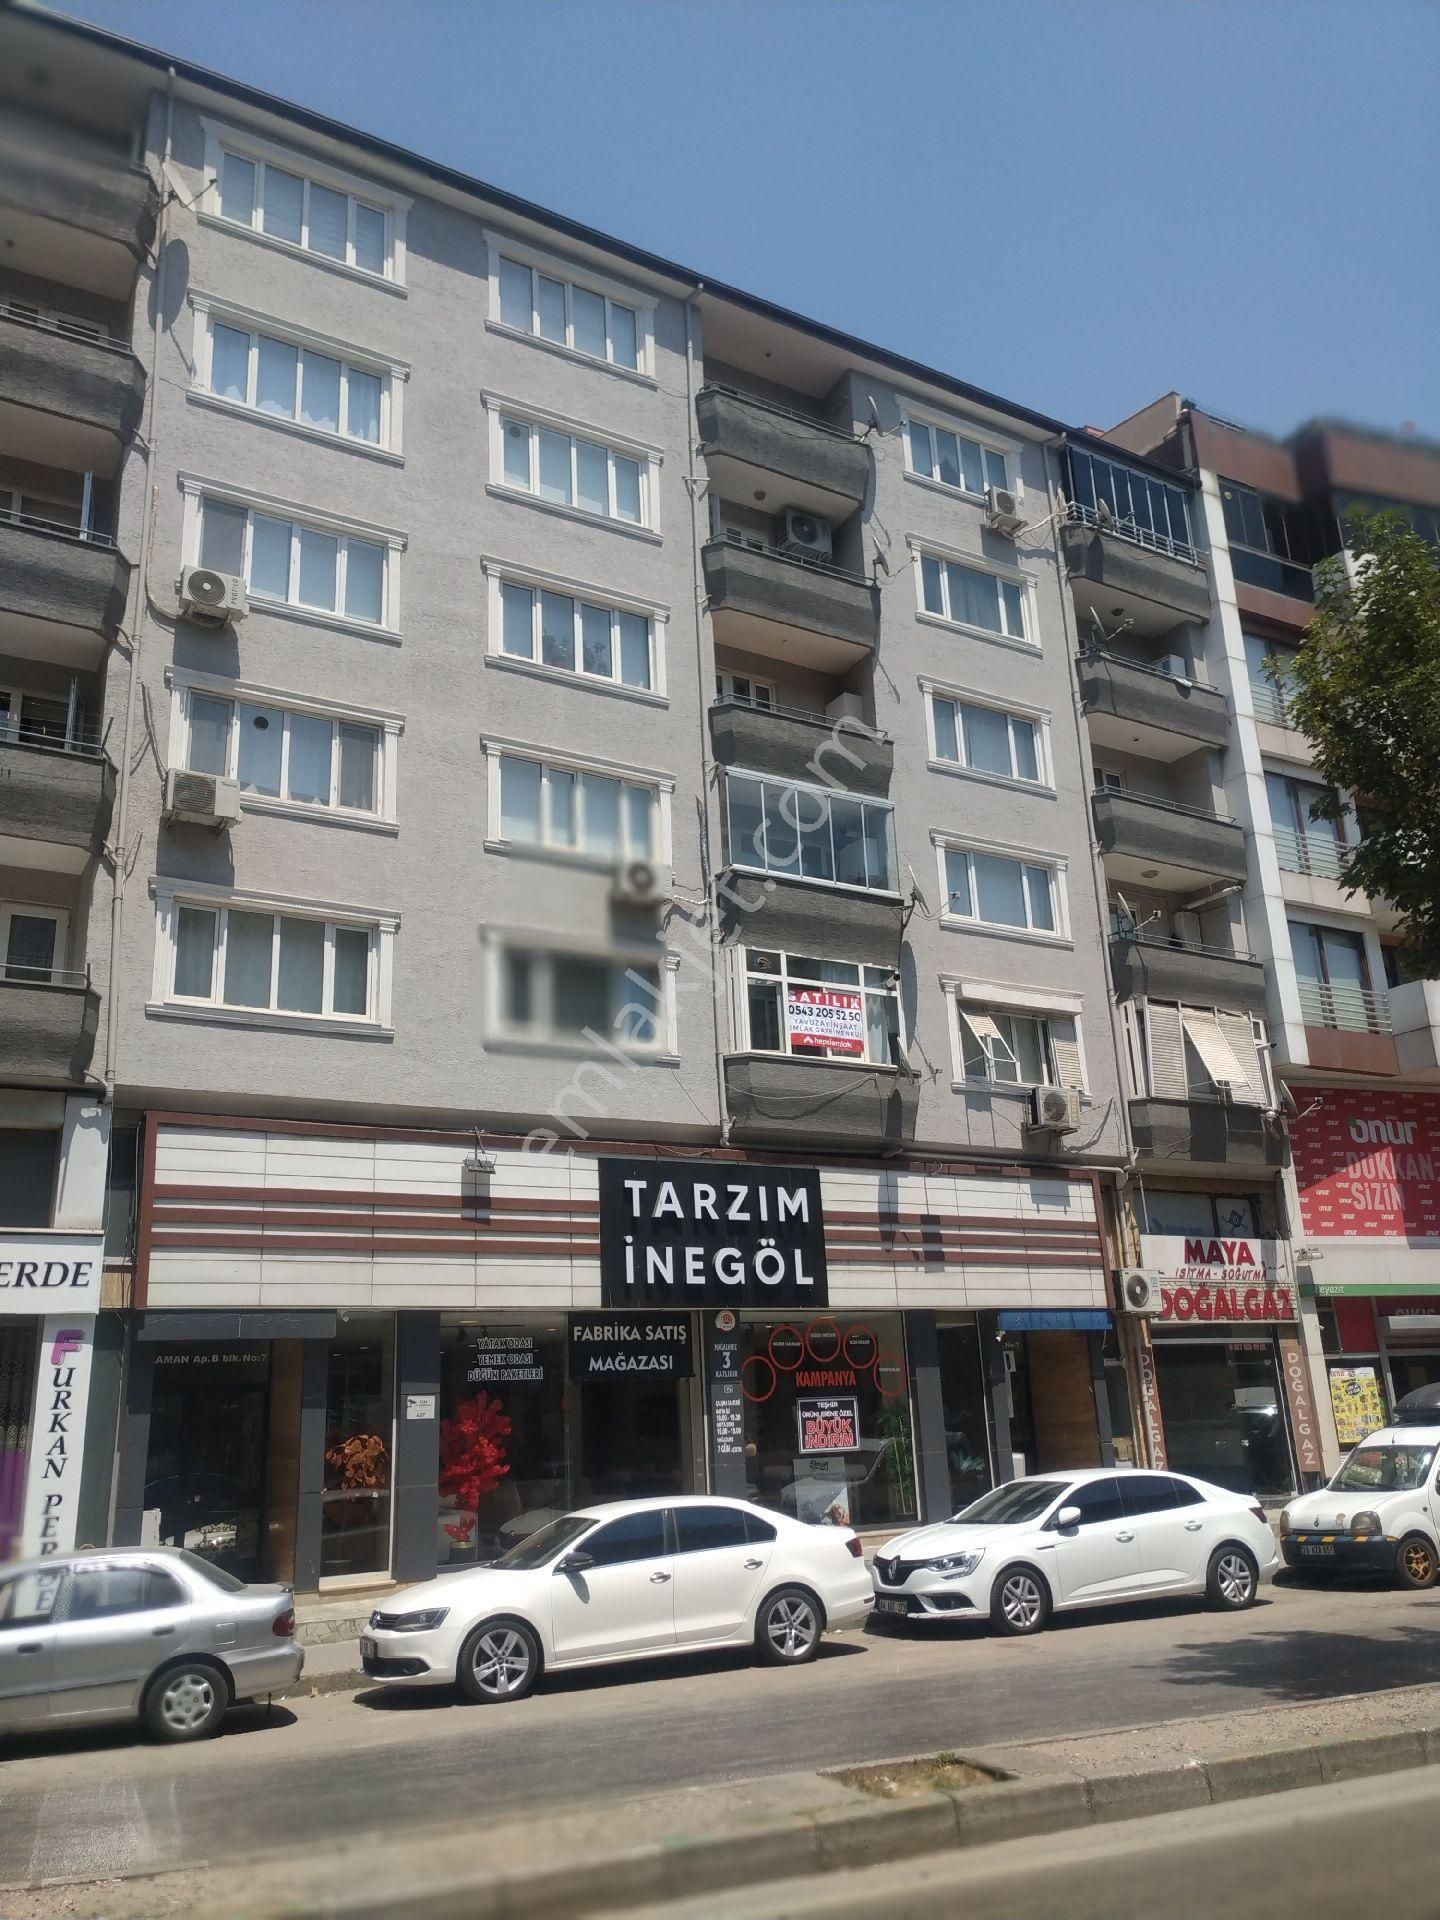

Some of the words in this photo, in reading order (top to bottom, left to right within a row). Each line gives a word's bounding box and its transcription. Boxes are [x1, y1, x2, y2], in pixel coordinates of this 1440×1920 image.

[788, 991, 860, 1009] SATILIK
[789, 1004, 814, 1017] 0543
[816, 1007, 833, 1019] 205
[836, 1010, 847, 1021] 52
[849, 1012, 861, 1022] 50
[814, 1037, 853, 1048] hepsiemlak
[1350, 1118, 1417, 1145] onur
[1346, 1150, 1435, 1181] DÜKKAN
[624, 1179, 810, 1224] TARZIM
[1351, 1181, 1406, 1212] SİZİN
[624, 1235, 815, 1286] İNEGÖL
[1184, 1239, 1256, 1266] MAYA
[1221, 1267, 1267, 1281] SOĞUTMA
[1160, 1281, 1294, 1321] DOĞALGAZ
[573, 1321, 642, 1341] FABRİKA
[645, 1325, 687, 1345] SATIŞ
[477, 1338, 507, 1350] YATAK
[507, 1337, 534, 1349] ODASI
[477, 1353, 506, 1366] YEMEK
[507, 1353, 534, 1365] ODASI
[588, 1351, 673, 1372] MAĞAZASI
[722, 1352, 731, 1369] 3
[467, 1368, 500, 1382] DÜĞÜN
[501, 1366, 544, 1381] PAKETLERİ
[796, 1369, 857, 1388] KAMPANYA
[41, 1329, 86, 1481] FURKAN
[1287, 1352, 1317, 1465] DOĞALGAZ
[805, 1417, 853, 1435] BÜYÜK
[804, 1432, 855, 1449] İNDİRİM
